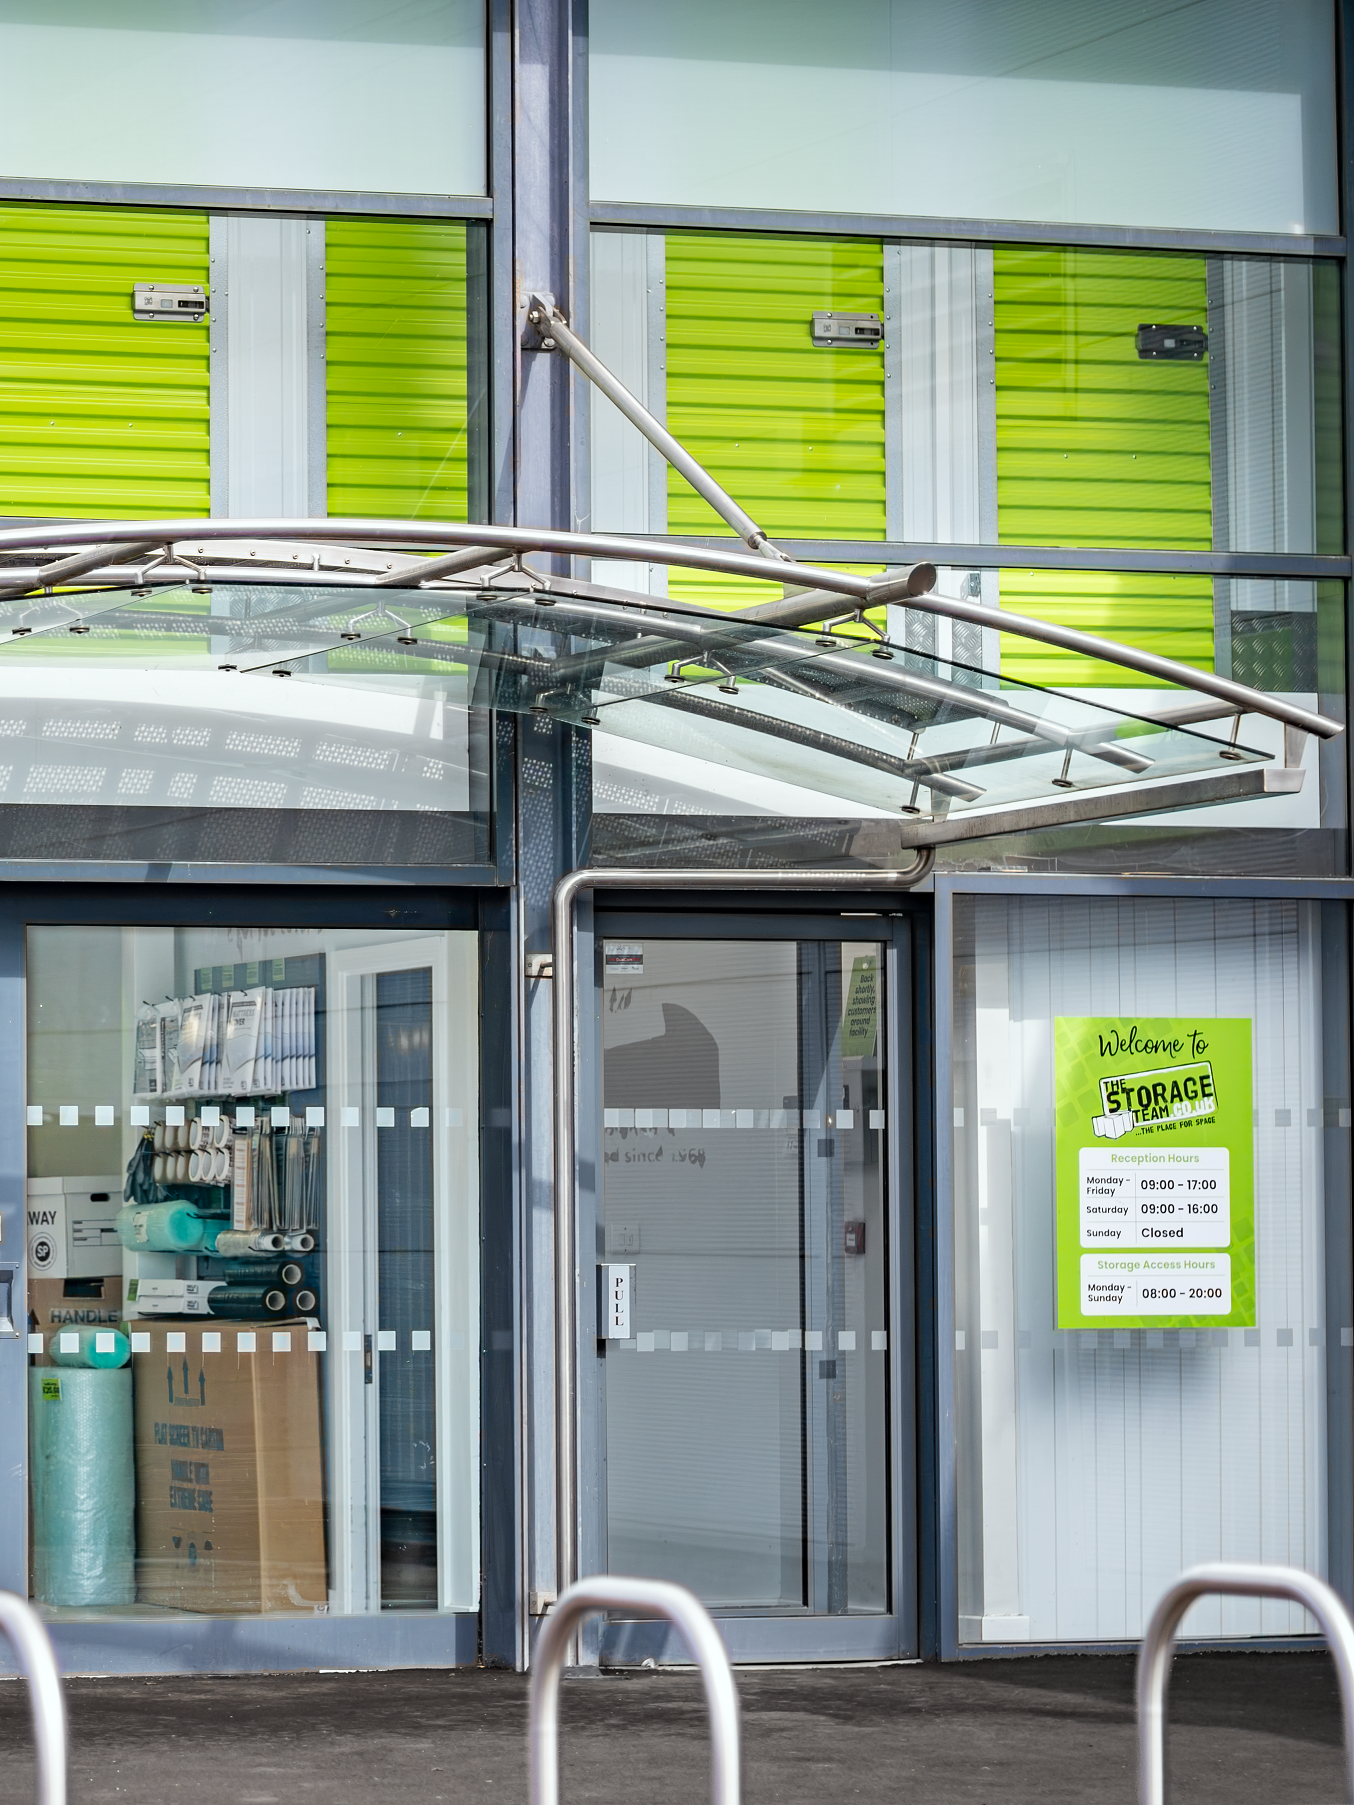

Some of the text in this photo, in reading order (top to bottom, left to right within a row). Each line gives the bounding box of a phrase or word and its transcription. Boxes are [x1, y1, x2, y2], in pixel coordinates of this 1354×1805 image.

[852, 995, 876, 1006] showing
[848, 1007, 877, 1016] customers
[850, 1016, 871, 1026] around
[1099, 1025, 1209, 1059] Welcome to
[1103, 1078, 1127, 1094] THE
[1106, 1074, 1214, 1113] STORAGE
[1157, 1123, 1177, 1132] PLACE
[1179, 1120, 1193, 1129] FOR
[1195, 1116, 1216, 1126] SPACE
[1111, 1153, 1200, 1165] Reception Hours
[1086, 1176, 1124, 1187] Monday
[1140, 1179, 1175, 1190] 09:00
[1187, 1179, 1217, 1190] 17:00
[1086, 1186, 1116, 1197] Friday
[1086, 1205, 1129, 1216] Saturday
[1140, 1203, 1175, 1214] 09:00
[1187, 1203, 1219, 1214] 16:00
[27, 1211, 57, 1225] WAY
[1086, 1227, 1184, 1239] Sunday Closed
[1097, 1260, 1216, 1272] Storage Access Hours
[1087, 1283, 1125, 1294] Monday
[1142, 1288, 1177, 1299] 08:00
[1188, 1288, 1223, 1299] 20:00
[615, 1277, 624, 1326] PULL
[1087, 1294, 1123, 1304] Sunday
[50, 1308, 118, 1324] HANDLE
